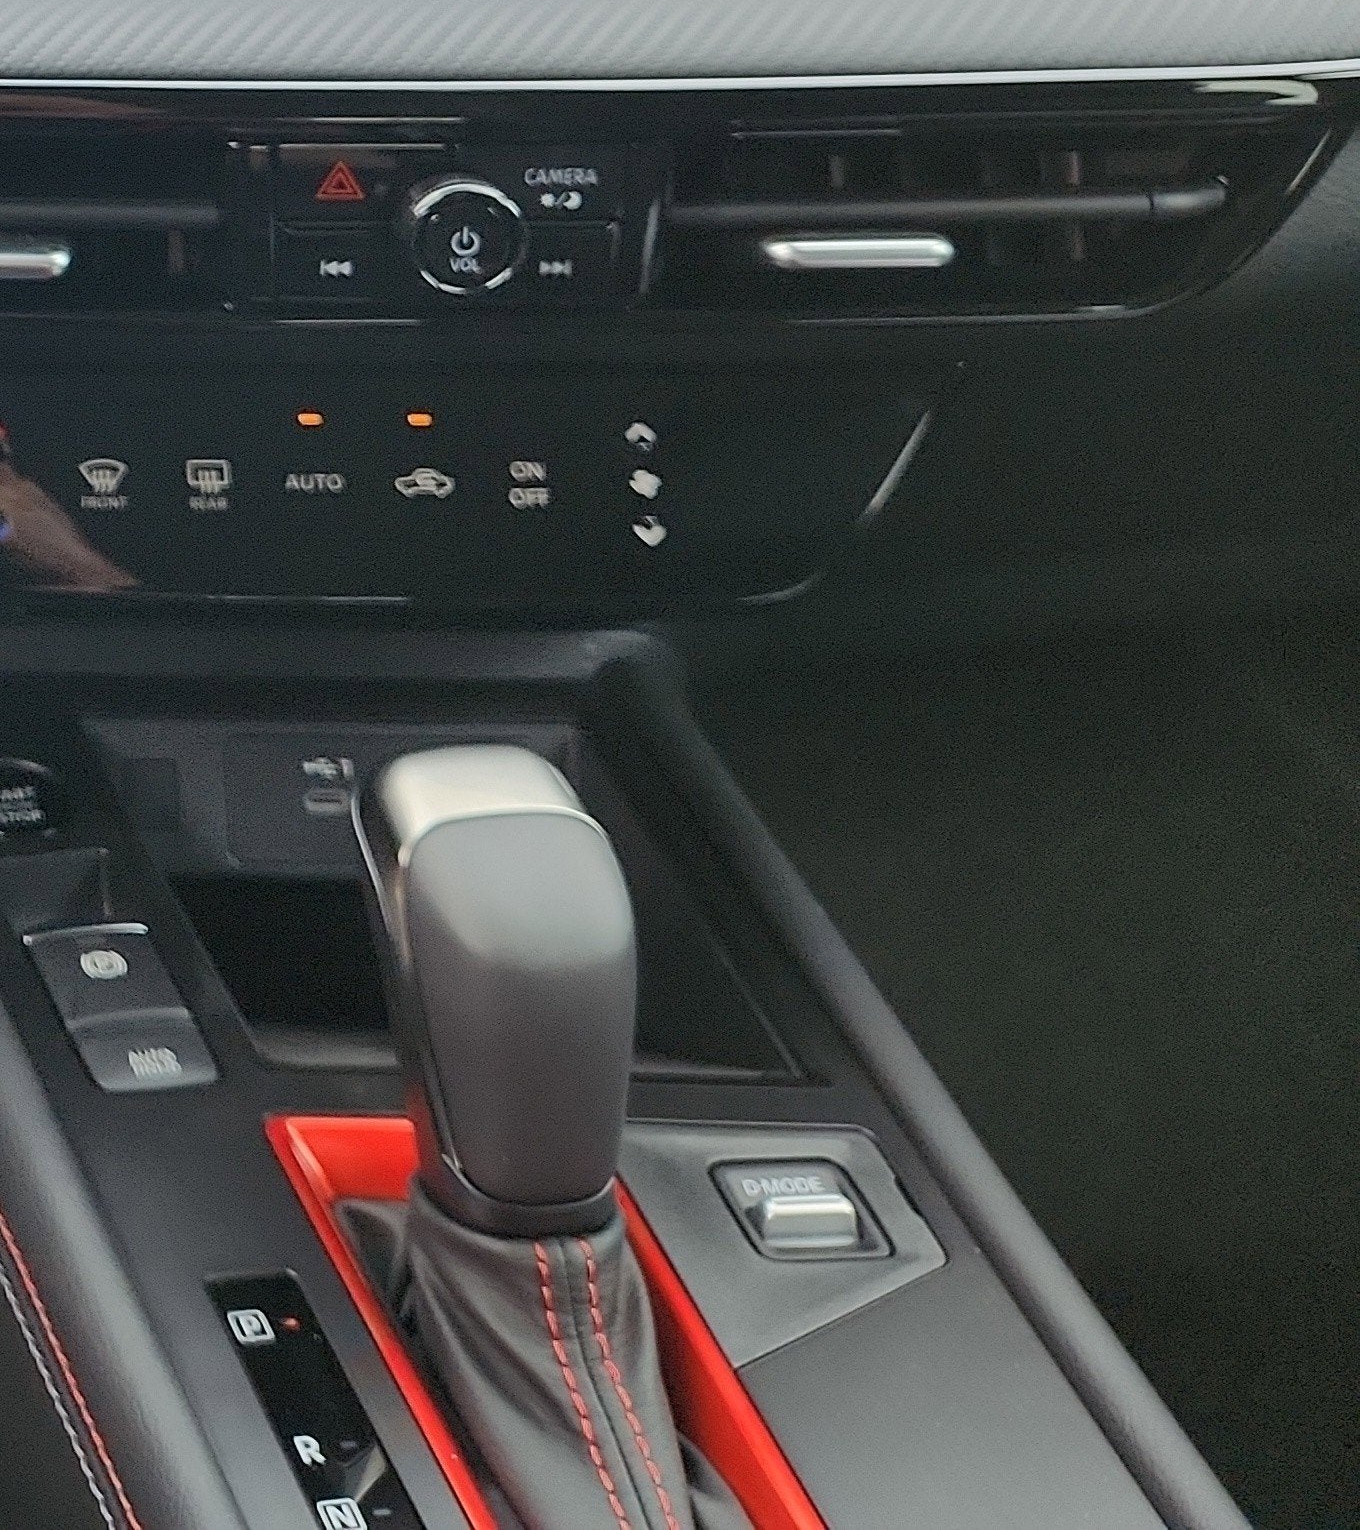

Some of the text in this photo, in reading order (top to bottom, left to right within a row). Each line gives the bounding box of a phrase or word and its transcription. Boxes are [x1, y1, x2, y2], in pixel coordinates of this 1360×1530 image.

[524, 168, 599, 186] CAMERA
[449, 257, 482, 274] VOL
[509, 461, 547, 482] ON
[285, 473, 345, 493] AUTO
[508, 487, 550, 510] OFF
[741, 1175, 826, 1197] D-MODE
[293, 1434, 327, 1467] R
